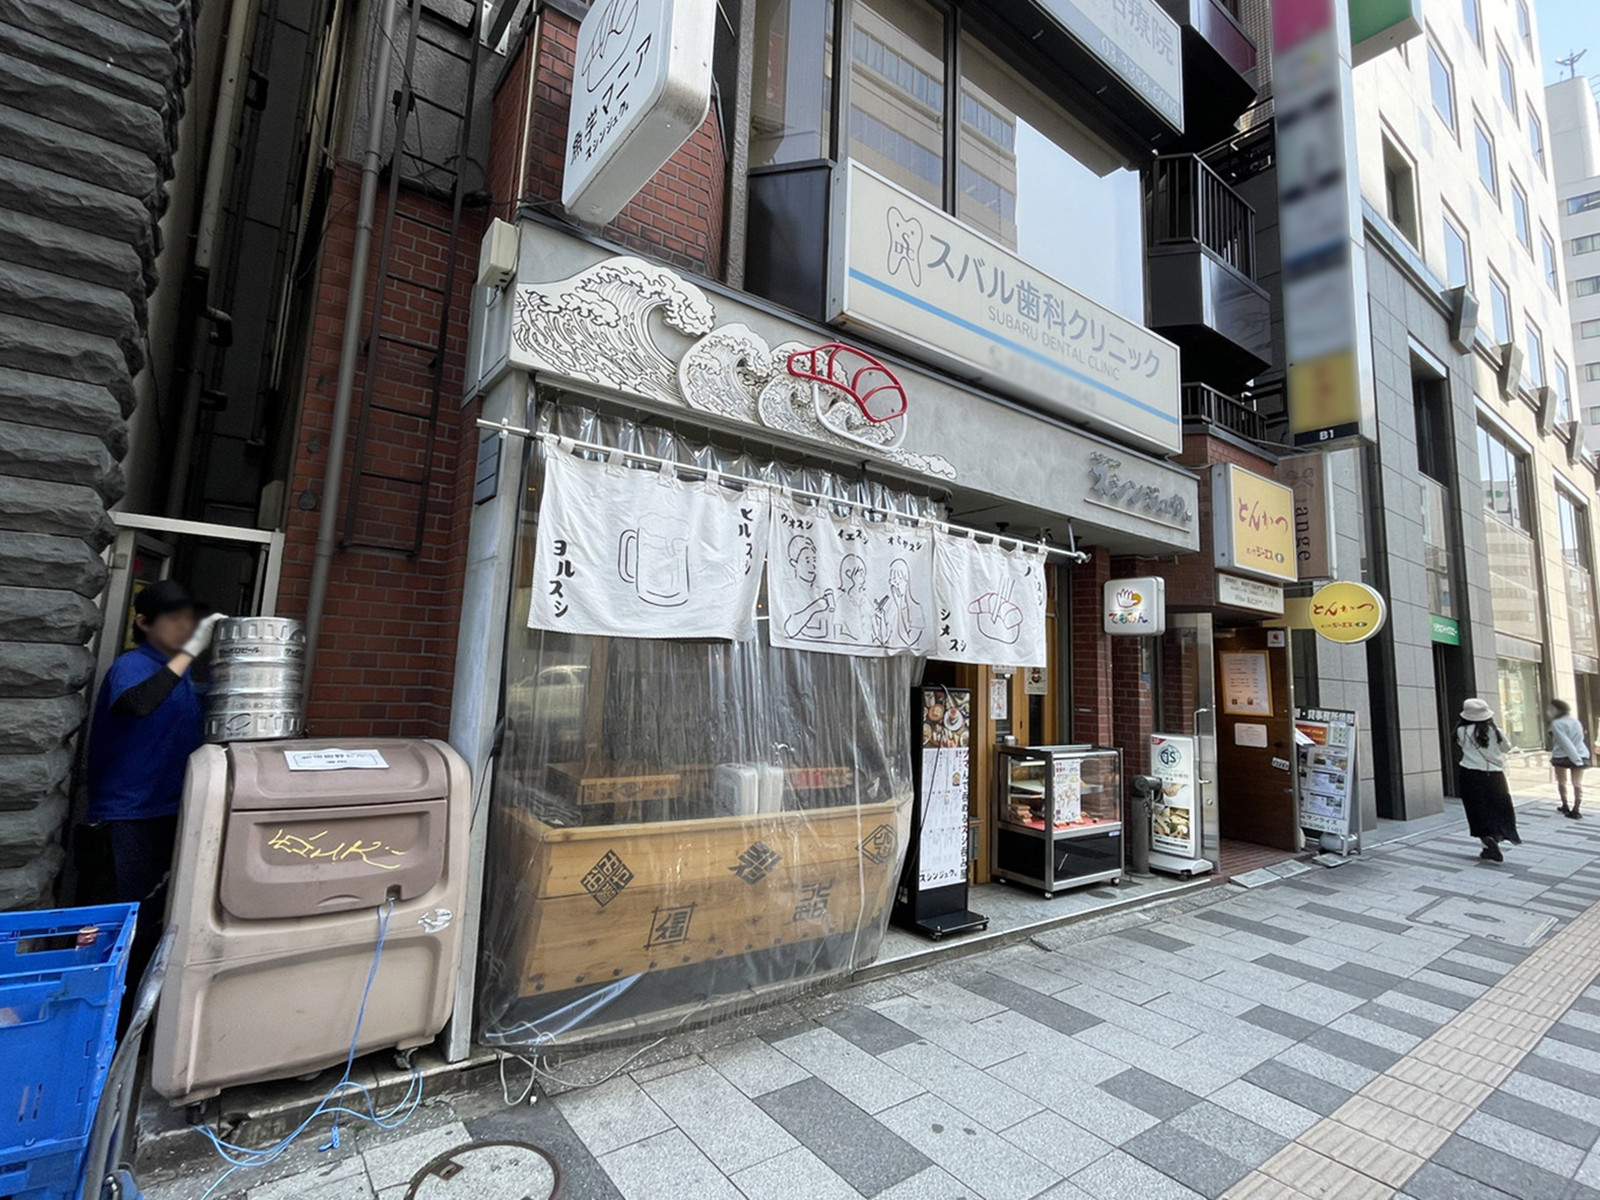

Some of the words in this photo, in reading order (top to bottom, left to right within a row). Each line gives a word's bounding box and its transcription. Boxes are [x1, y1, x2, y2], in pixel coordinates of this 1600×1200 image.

[927, 234, 1160, 380] スバル歯科クリニック
[988, 306, 1039, 341] SUBARU
[1042, 332, 1085, 365] DENTAL
[1088, 356, 1121, 381] CLINIC
[1319, 429, 1334, 440] B1
[781, 513, 813, 530] ウオスシ
[1238, 498, 1288, 535] とんかつ
[738, 508, 753, 576] ヒルスシ
[838, 529, 869, 545] イエスシ
[548, 540, 575, 618] ヨルスシ
[1313, 601, 1375, 616] とんかつ
